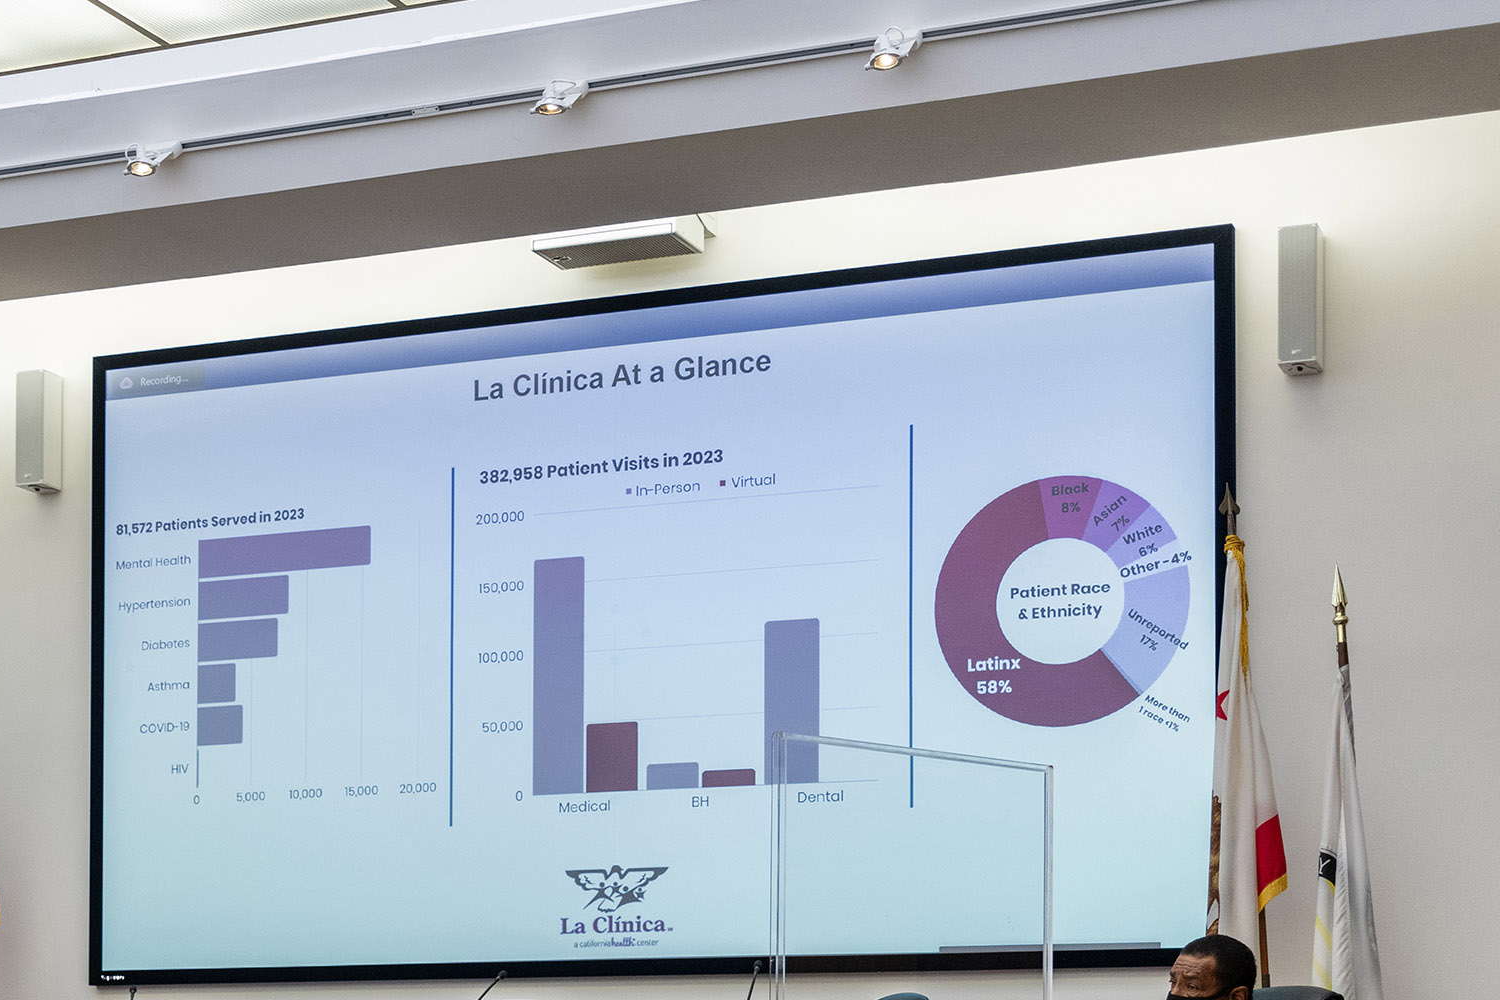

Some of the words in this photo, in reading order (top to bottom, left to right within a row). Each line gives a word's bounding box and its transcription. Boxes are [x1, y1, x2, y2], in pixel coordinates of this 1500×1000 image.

[474, 379, 503, 401] La
[513, 370, 604, 397] Clínica
[611, 363, 641, 387] At
[650, 366, 665, 383] a
[674, 354, 772, 381] Glance
[479, 466, 544, 485] 382,958
[547, 460, 609, 478] Patient
[612, 454, 660, 473] Visits
[663, 452, 679, 468] in
[682, 449, 724, 466] 2023
[635, 481, 701, 497] In-Person
[731, 474, 776, 489] Virtual
[1051, 482, 1089, 497] Black
[1061, 501, 1081, 513] 8%
[1092, 494, 1128, 527] Asian
[116, 522, 153, 536] 81,572
[155, 517, 209, 533] Patients
[211, 511, 256, 526] Served
[259, 511, 271, 523] in
[274, 508, 305, 522] 2023
[475, 510, 525, 526] 200,000
[1110, 515, 1130, 533] 7%
[1122, 522, 1163, 545] White
[1138, 543, 1158, 557] 6%
[116, 556, 153, 570] Mental
[155, 554, 192, 567] Health
[1120, 559, 1161, 579] Other
[478, 581, 525, 595] 150,000
[1010, 583, 1067, 600] Patient
[1071, 582, 1111, 596] Race
[118, 597, 191, 614] Hypertension
[1018, 608, 1029, 620] &
[1031, 604, 1103, 620] Ethnicity
[1128, 608, 1190, 650] Unreported
[141, 638, 191, 651] Diabetes
[1139, 634, 1158, 651] 17%
[477, 650, 524, 665] 100,000
[967, 656, 1021, 672] Latinx
[147, 680, 190, 692] Asthma
[976, 679, 1012, 695] 58%
[1143, 708, 1165, 725] race
[1144, 694, 1170, 714] More
[1169, 706, 1191, 723] than
[139, 721, 190, 735] COVID-19
[481, 719, 524, 735] 50,000
[171, 763, 189, 775] HIV
[288, 788, 323, 801] 10,000
[344, 784, 379, 798] 15,000
[399, 782, 438, 795] 20,000
[515, 790, 524, 803] 0
[797, 789, 844, 804] Dental
[193, 794, 201, 806] 0
[236, 791, 266, 804] 5,000
[691, 795, 710, 808] BH
[558, 800, 611, 814] Medical
[560, 917, 586, 935] La
[592, 915, 666, 933] Clínica
[579, 940, 611, 948] california
[636, 939, 659, 947] center
